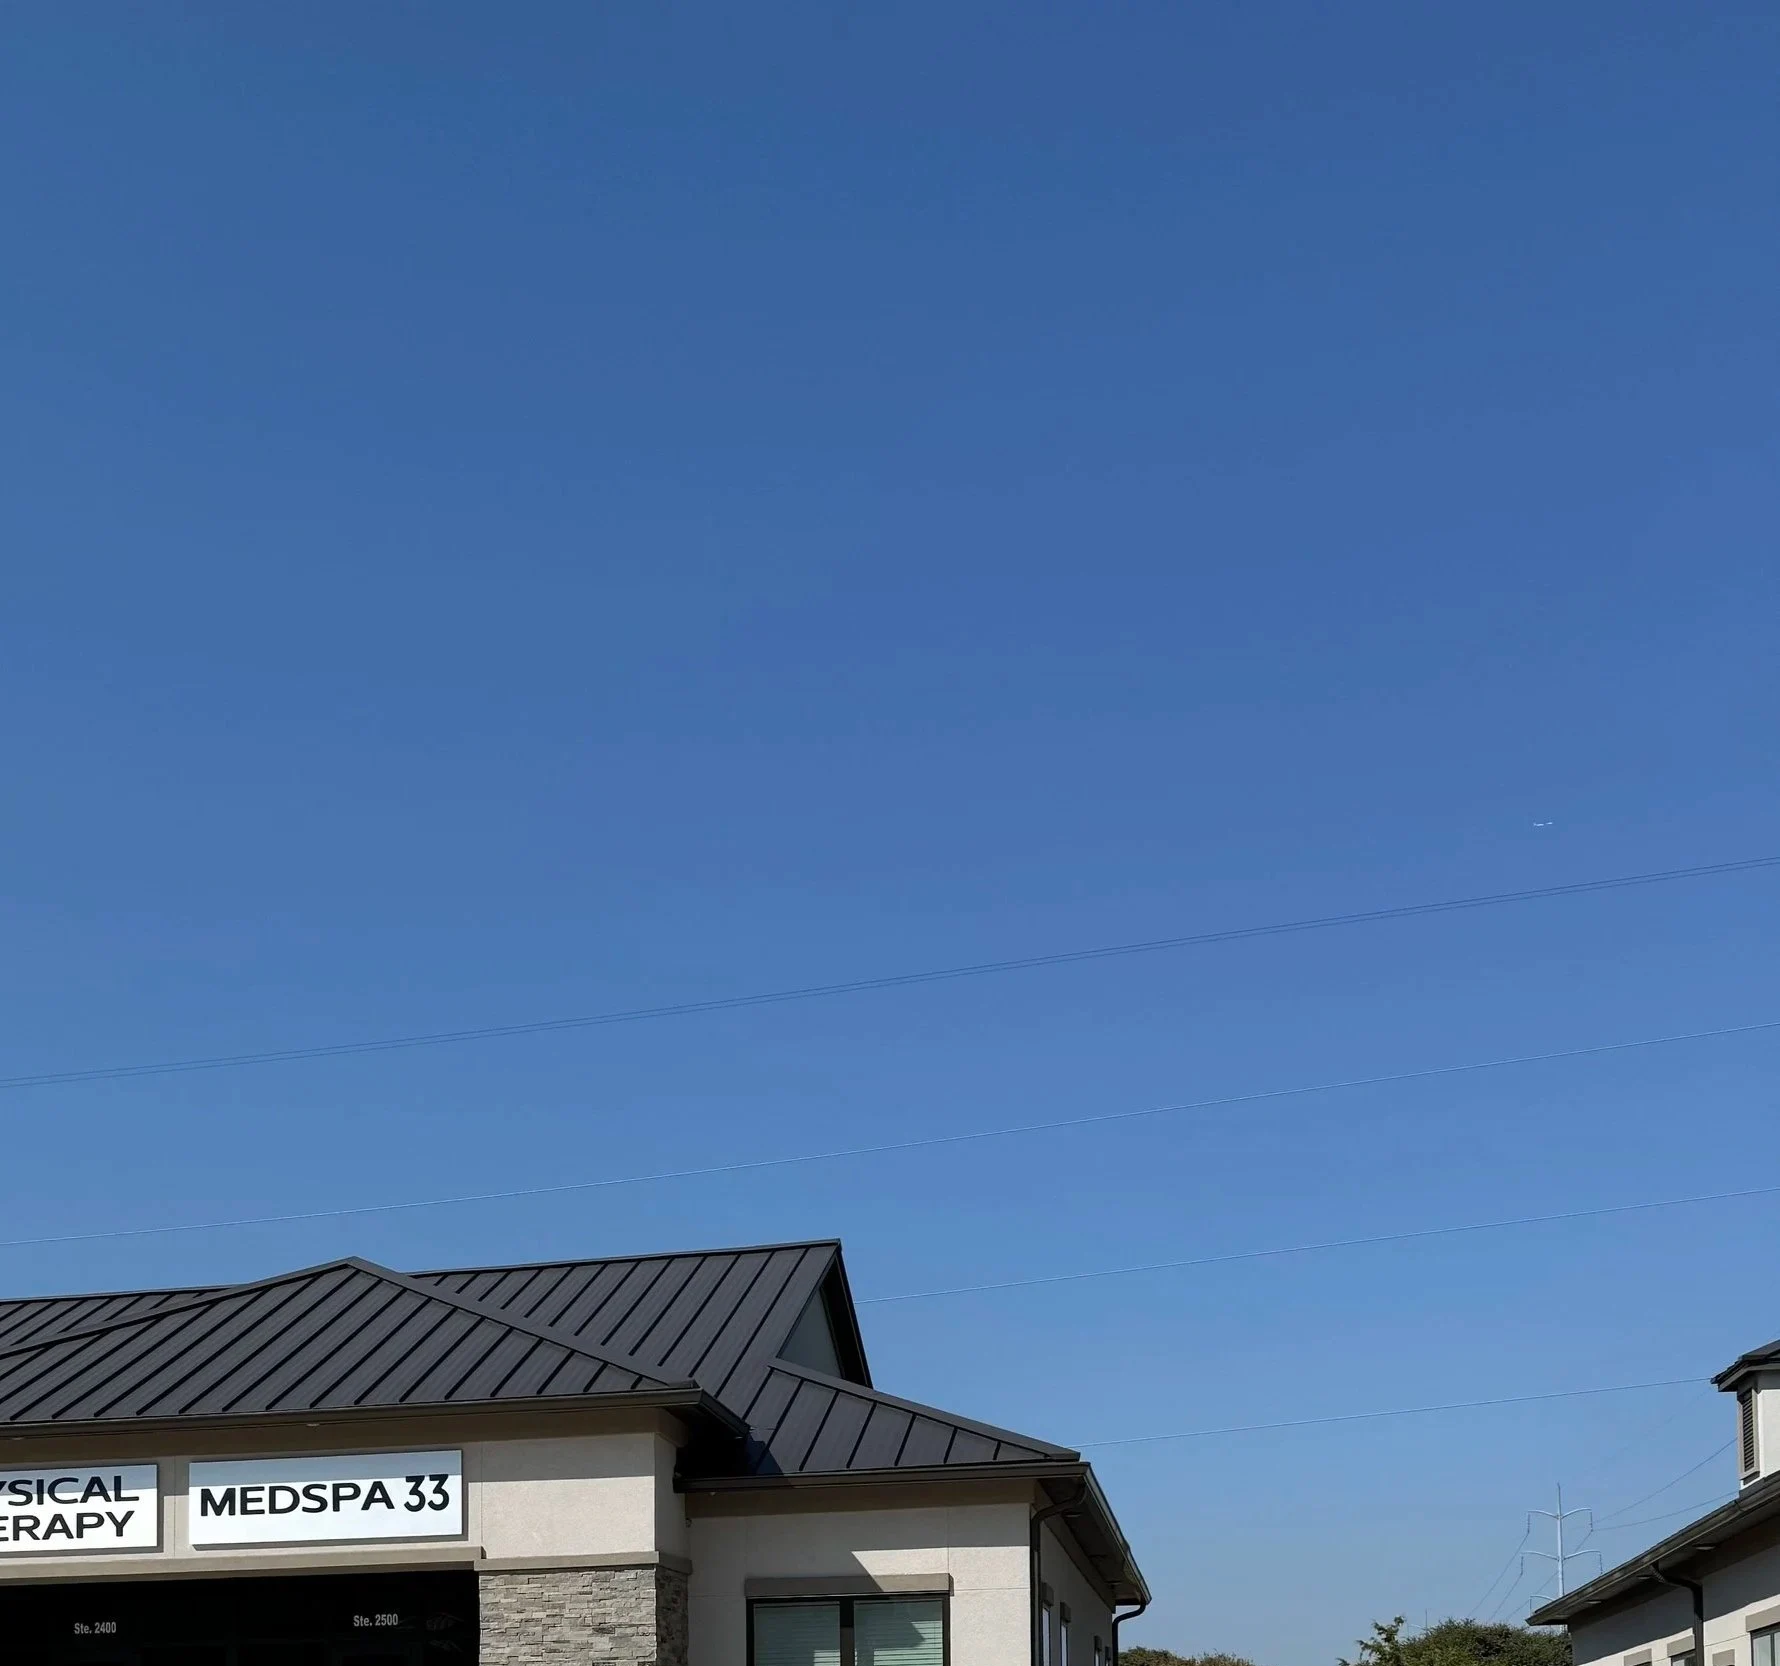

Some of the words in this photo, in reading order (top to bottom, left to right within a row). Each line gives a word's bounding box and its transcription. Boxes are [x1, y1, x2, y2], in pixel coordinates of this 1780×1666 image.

[0, 1475, 140, 1507] SICAL
[200, 1480, 395, 1517] MEDSPA
[404, 1473, 450, 1512] 33
[74, 1622, 92, 1635] Ste.
[94, 1621, 117, 1634] 2400
[353, 1614, 373, 1627] Ste.
[375, 1613, 399, 1626] 2500
